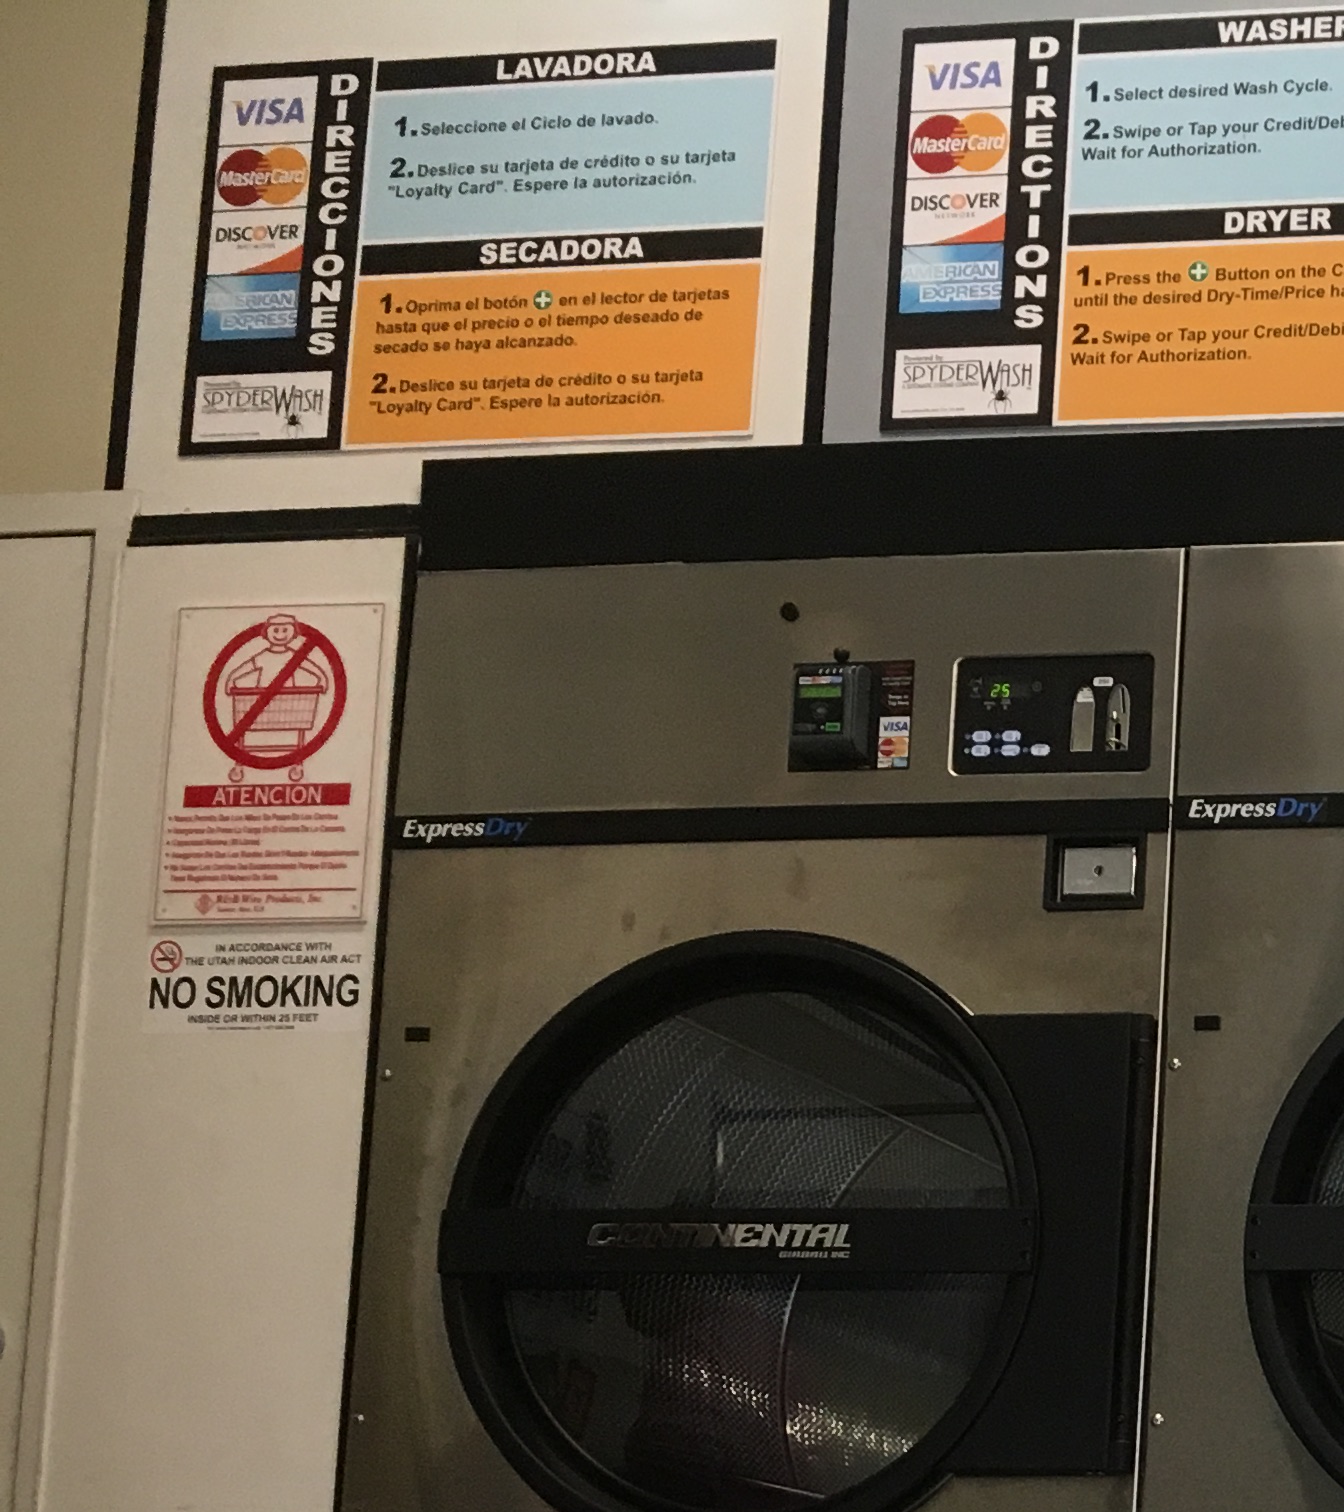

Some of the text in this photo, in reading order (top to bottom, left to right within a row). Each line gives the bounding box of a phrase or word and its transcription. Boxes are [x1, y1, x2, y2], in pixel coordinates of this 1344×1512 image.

[496, 51, 657, 81] LAVADORA
[924, 60, 1002, 90] VISA
[1085, 78, 1333, 103] 1. Select desired Wash Cycle.
[231, 97, 305, 127] VISA
[395, 112, 658, 137] 1. Seleccione el Ciclo de lavado.
[1083, 118, 1109, 141] 2.
[1113, 123, 1161, 142] Swipe
[1167, 124, 1183, 137] or
[1188, 120, 1217, 138] Tap
[1222, 120, 1258, 137] your
[912, 133, 1005, 154] MasterCard
[1082, 140, 1262, 161] Wait for Authorization.
[390, 149, 736, 178] 2. Deslice su tarjeta de crédito o su tarjeta
[220, 168, 305, 187] MasterCard
[513, 177, 569, 194] Espere
[574, 176, 587, 189] la
[593, 170, 696, 188] autorización.
[1014, 36, 1060, 329] DIRECTIONS
[911, 192, 1001, 211] DISCOVER
[307, 73, 360, 355] DIRECCIONES
[1223, 207, 1332, 235] DRYER
[215, 224, 299, 242] DISCOVER
[480, 236, 644, 265] SECADORA
[1076, 264, 1101, 287] 1.
[1105, 270, 1151, 286] Press
[1157, 269, 1181, 285] the
[1215, 265, 1269, 282] Button
[1275, 266, 1295, 278] on
[1301, 263, 1326, 278] the
[380, 287, 730, 315] 1. Oprima el botón en el lector de tarjetas
[922, 284, 1002, 300] EXPRESS
[1073, 291, 1108, 308] until
[1113, 290, 1138, 306] the
[1142, 287, 1202, 305] desired
[1207, 283, 1325, 306] Dry-Time/Price
[220, 311, 297, 330] EXPRESS
[1072, 323, 1098, 345] 2.
[1102, 327, 1151, 346] Swipe
[1156, 329, 1173, 342] or
[1178, 326, 1207, 343] Tap
[1212, 325, 1249, 342] your
[1070, 345, 1252, 366] Wait for Authorization.
[991, 684, 1010, 697] 25
[883, 721, 908, 731] VISA
[212, 785, 322, 805] ATENCION
[1188, 797, 1323, 823] ExpressDry
[402, 817, 529, 843] ExpressDry
[185, 954, 362, 965] THE UTAH INDOOR CLEAN AIR ACT
[215, 942, 332, 953] IN ACCORDANCE WITH
[149, 973, 360, 1009] NO SMOKING
[187, 1013, 319, 1024] INSIDE OR WITHIN 25 FEET
